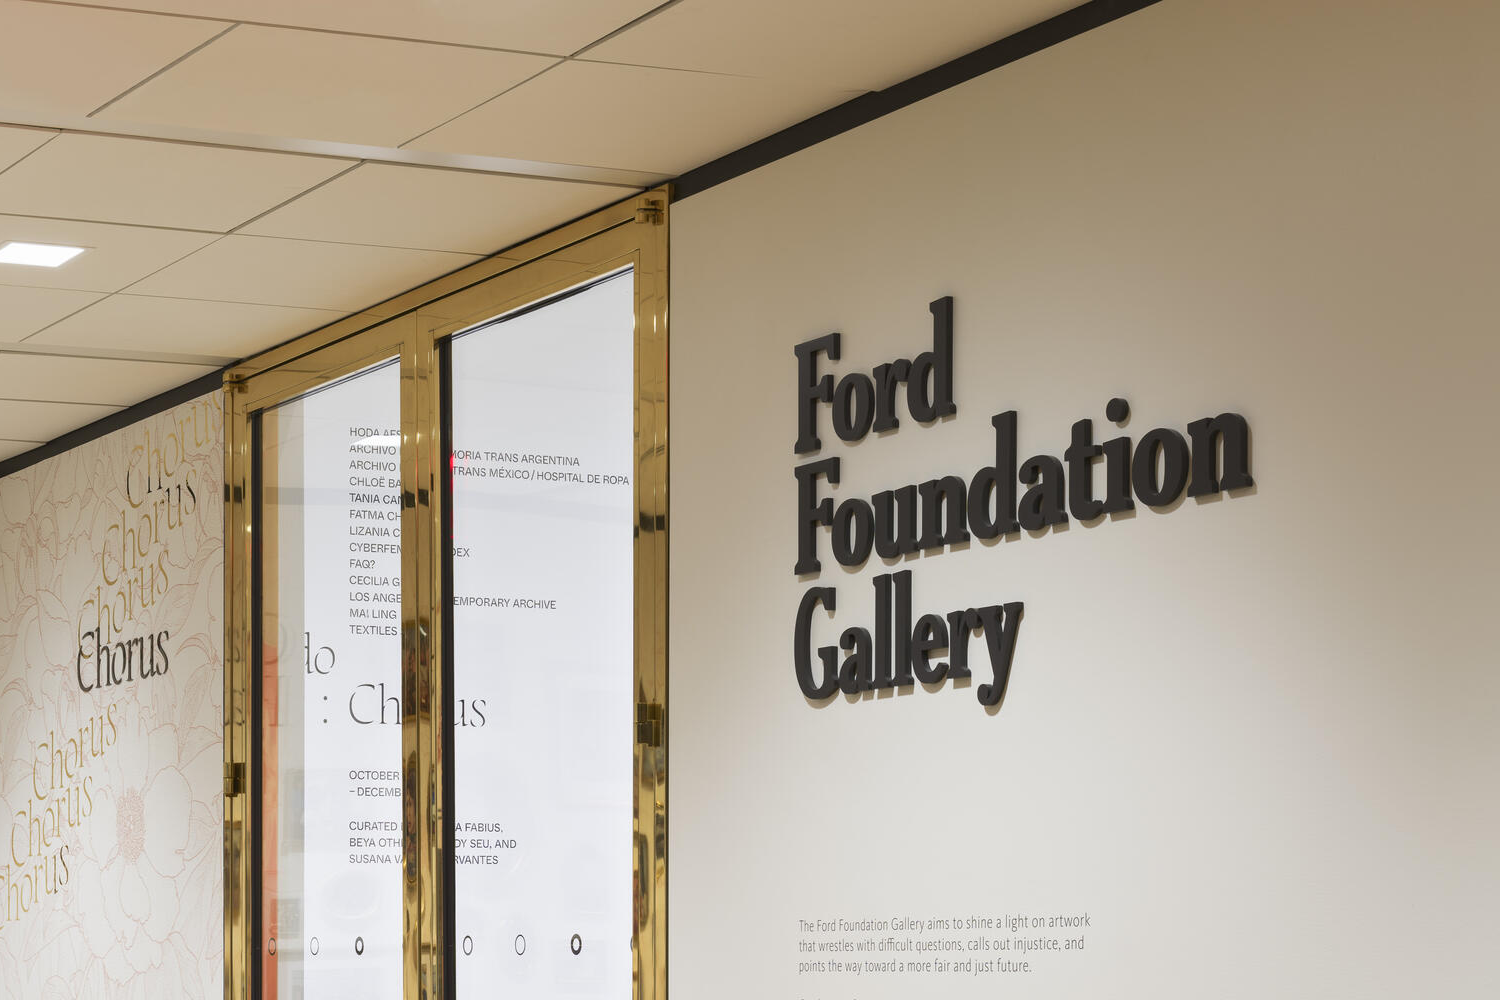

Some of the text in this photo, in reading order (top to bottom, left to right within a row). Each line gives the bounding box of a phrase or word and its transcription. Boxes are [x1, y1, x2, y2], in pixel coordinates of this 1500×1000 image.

[794, 295, 957, 454] Ford
[349, 444, 397, 455] ARCHIVO
[483, 451, 519, 463] TRANS
[521, 454, 581, 466] ARGENTINA
[349, 460, 397, 472] ARCHIVO
[453, 466, 487, 477] TRANS
[587, 474, 600, 484] DE
[602, 475, 630, 486] ROPA
[349, 475, 386, 488] CHLOË
[794, 397, 1253, 575] Foundation
[349, 492, 381, 503] TANIA
[349, 509, 385, 520] FATMA
[102, 469, 197, 586] Chorus
[349, 525, 390, 537] LIZANIA
[349, 558, 376, 569] FAQ?
[349, 575, 389, 586] CECILIA
[78, 550, 169, 659] Chorus
[349, 591, 557, 610] LOS ANGE EMPORARY ARCHIVE
[372, 609, 397, 620] LING
[349, 625, 398, 636] TEXTILES
[794, 570, 1024, 706] Gallery
[77, 630, 169, 692] Chorus
[33, 704, 116, 800] Chorus
[349, 770, 400, 781] OCTOBER
[357, 787, 402, 797] DECEMB
[11, 776, 92, 867] Chorus
[349, 821, 398, 831] CURATED
[465, 822, 503, 833] FABIUS,
[349, 838, 376, 848] BEYA
[378, 838, 403, 848] OTH
[470, 839, 492, 850] SEU,
[494, 839, 517, 848] AND
[349, 854, 392, 864] SUSANA
[799, 920, 814, 932] The
[817, 919, 836, 932] Ford
[839, 919, 888, 931] Foundation
[891, 917, 924, 934] Gallery
[926, 917, 949, 930] aims
[953, 917, 963, 929] to
[966, 915, 992, 929] shine
[1005, 914, 1028, 932] light
[1032, 916, 1045, 928] on
[1048, 913, 1091, 928] artwork
[799, 935, 1084, 954] that wrestles with difficult questions, calls out injustice, and
[799, 959, 825, 975] points
[828, 960, 842, 972] the
[845, 962, 862, 975] way
[865, 959, 895, 974] toward
[908, 962, 931, 972] more
[935, 958, 950, 972] fair
[954, 958, 971, 972] and
[975, 959, 993, 976] just
[997, 958, 1031, 972] future.
